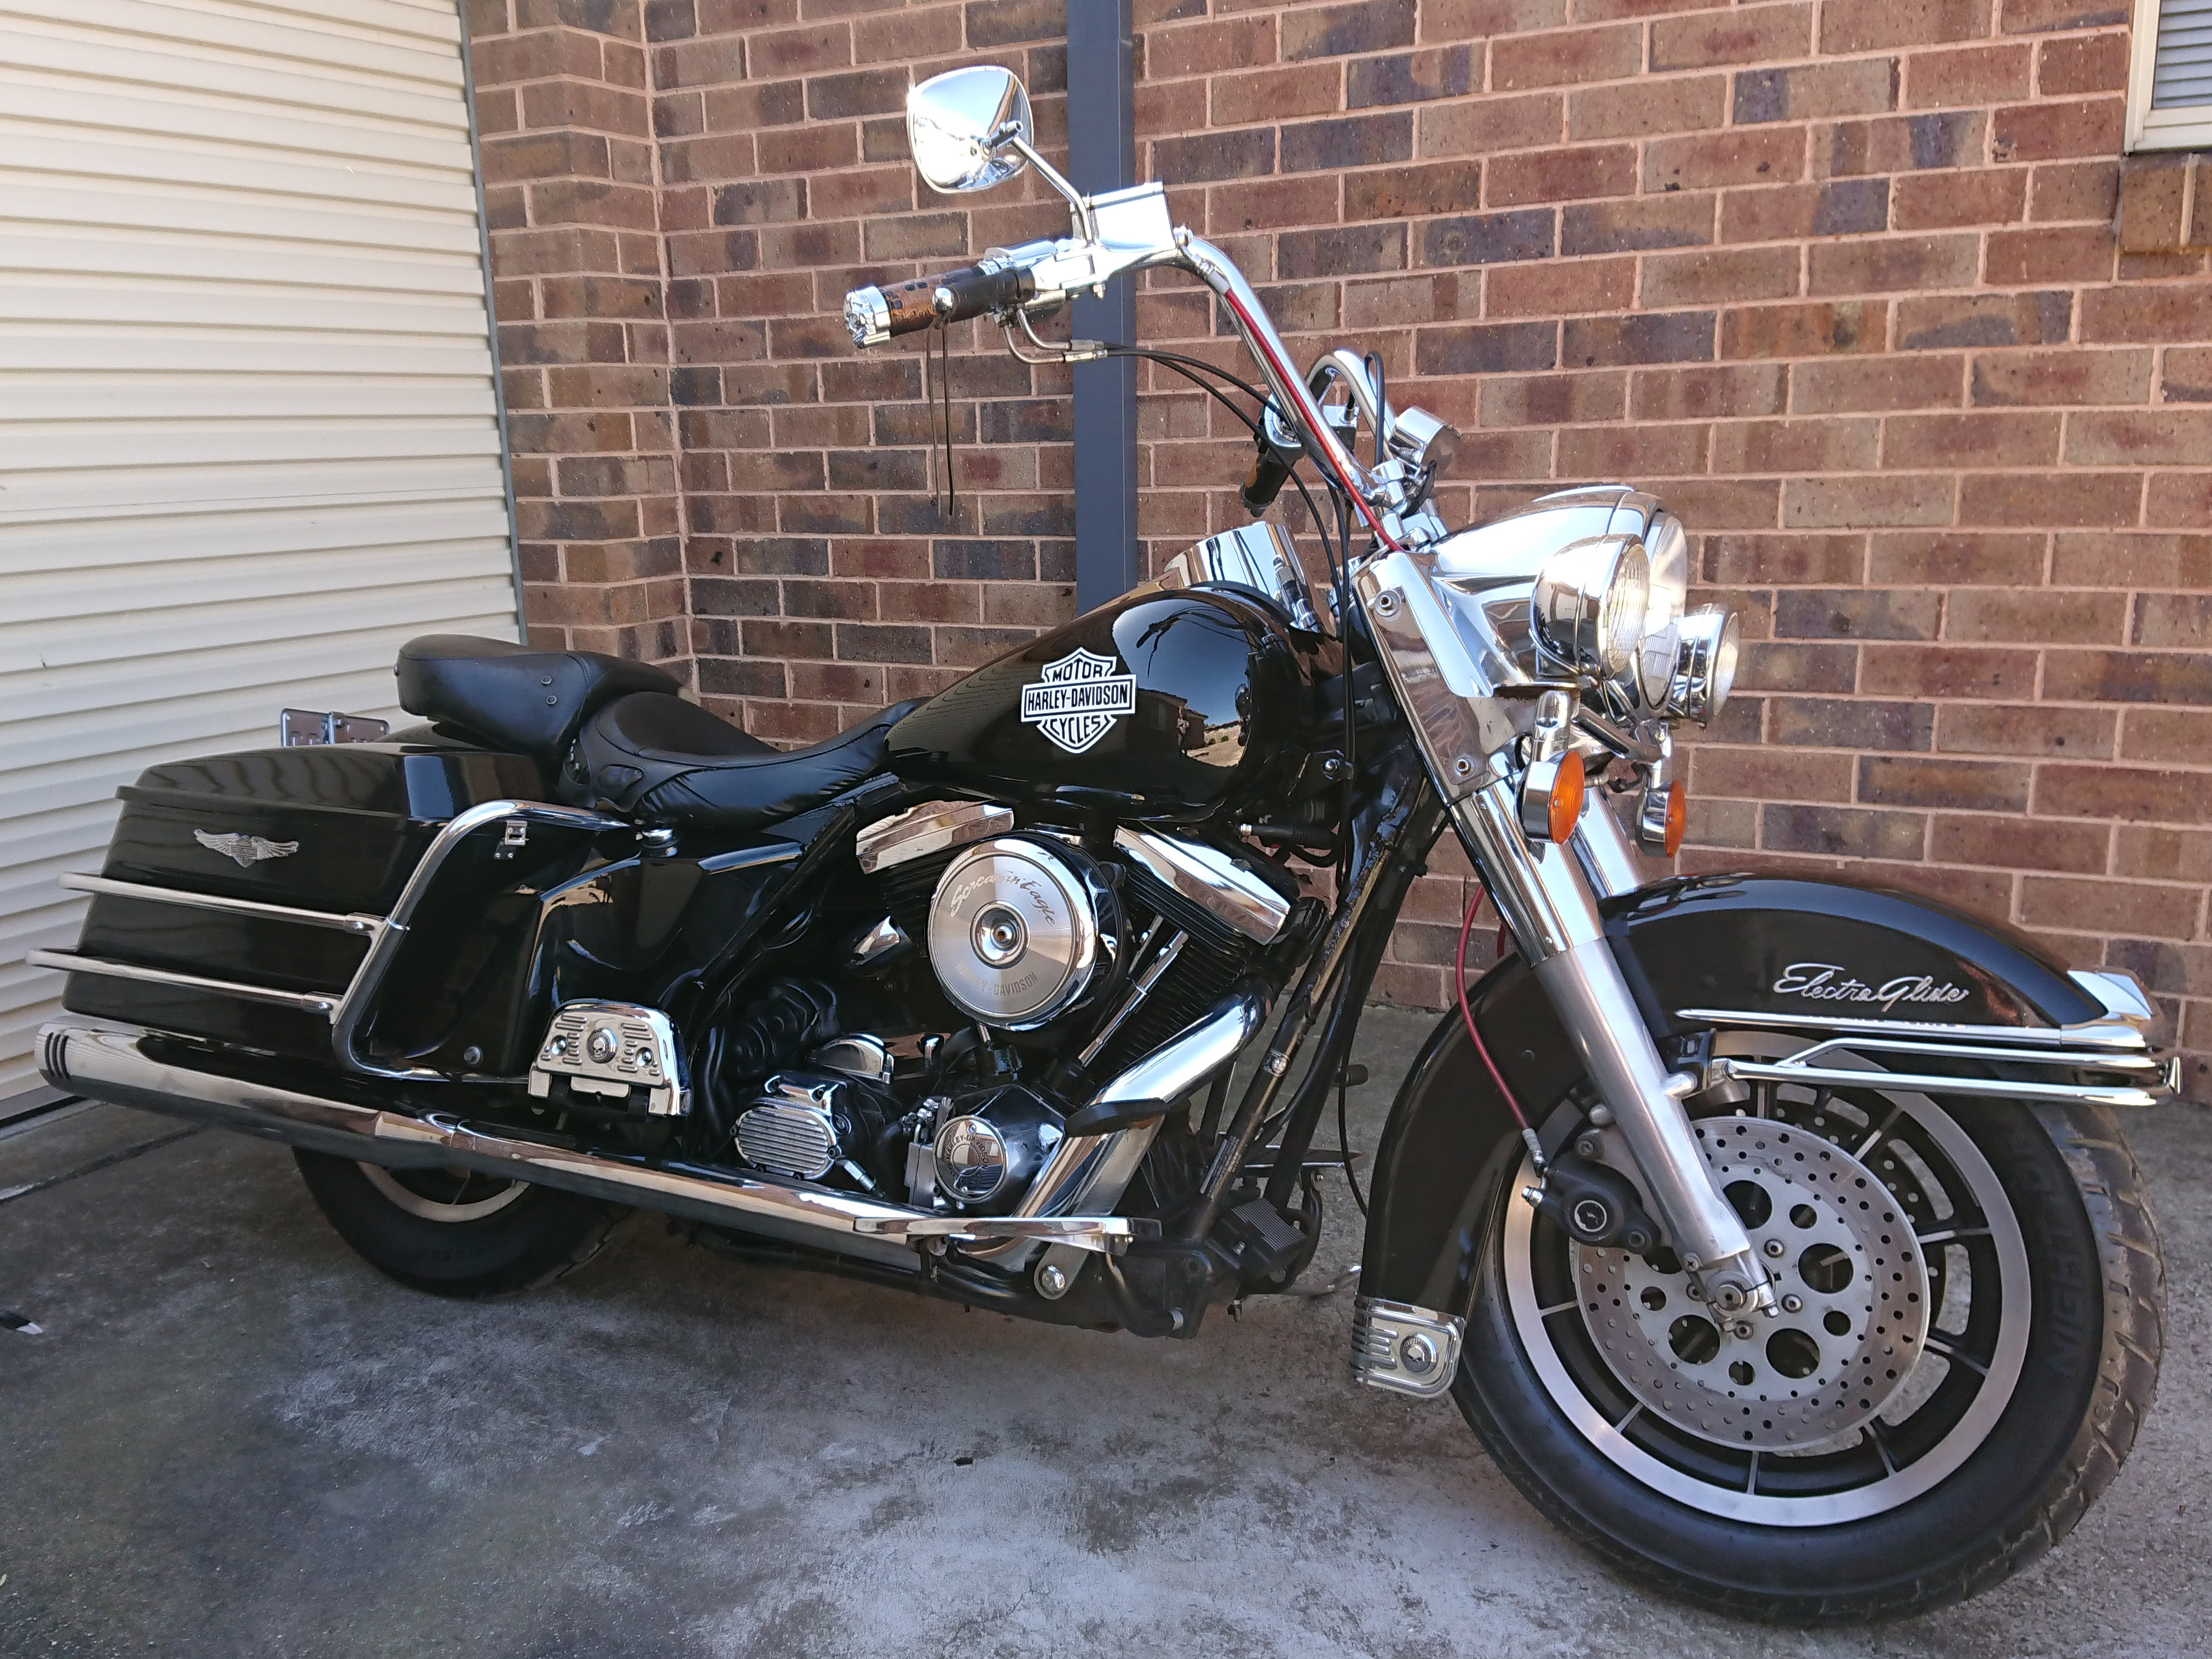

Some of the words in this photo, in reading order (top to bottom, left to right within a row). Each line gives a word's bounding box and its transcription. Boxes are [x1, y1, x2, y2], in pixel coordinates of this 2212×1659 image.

[1052, 658, 1102, 682] MOTOR
[1028, 684, 1128, 711] HARLEY-DAVIDSON
[1050, 714, 1100, 745] CYCLES
[1020, 880, 1055, 927] Eagle
[1773, 962, 1878, 1002] Electra
[1877, 975, 1970, 1013] Glide
[946, 1134, 989, 1170] HARLEY-DAVIDSON
